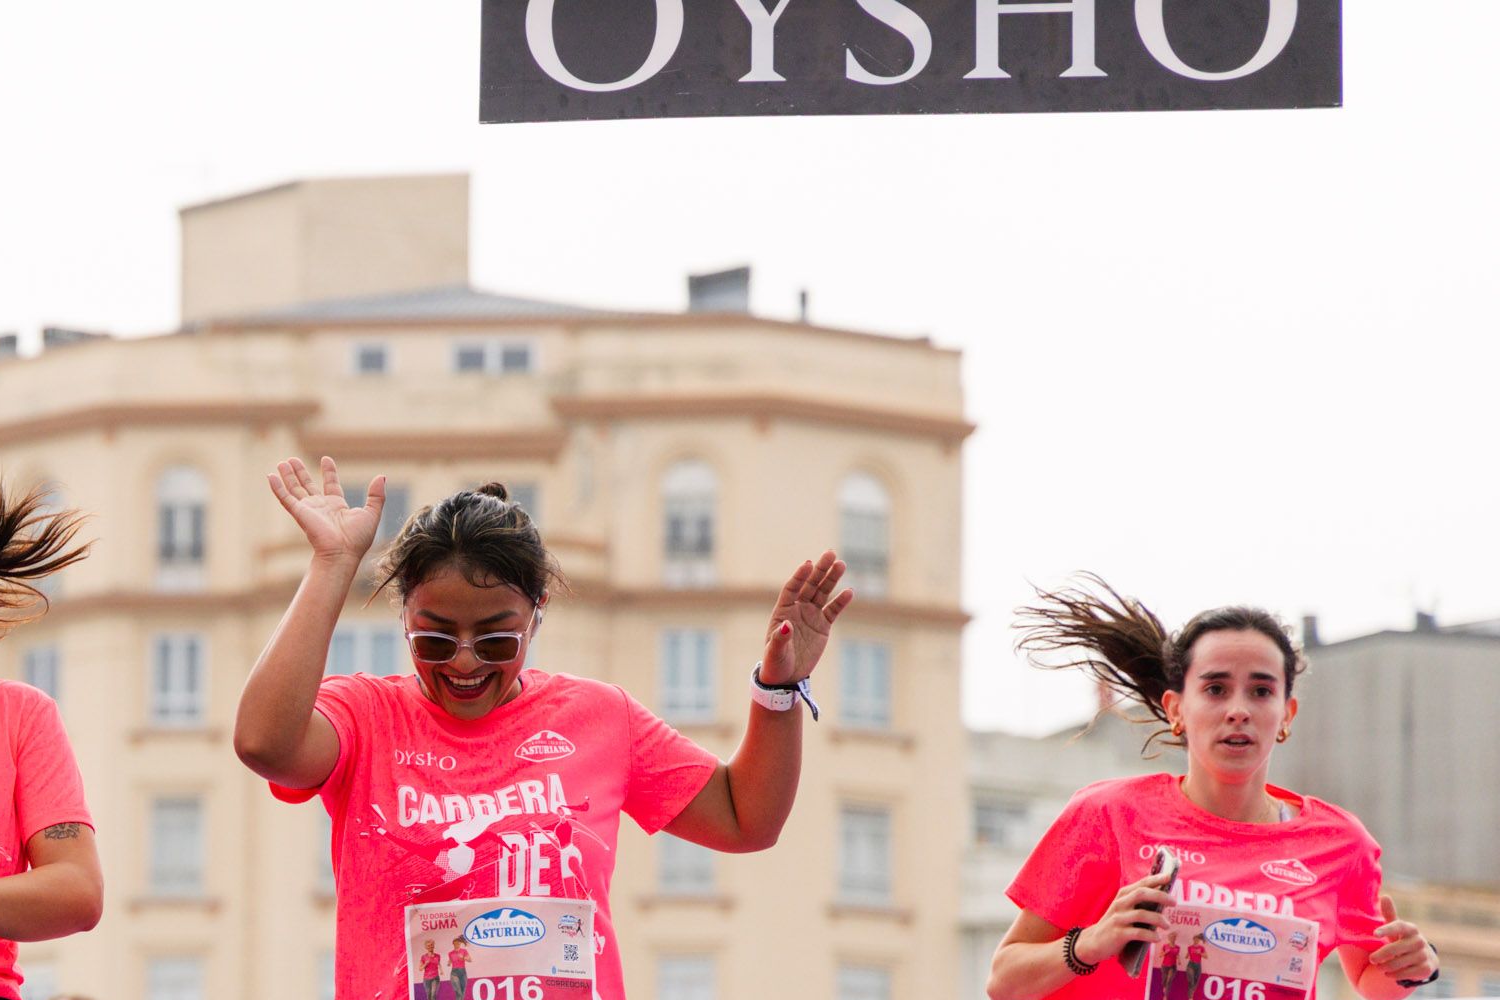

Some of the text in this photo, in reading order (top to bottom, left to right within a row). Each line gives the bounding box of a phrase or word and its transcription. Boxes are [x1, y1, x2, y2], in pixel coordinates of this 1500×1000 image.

[524, 0, 1299, 92] OYSHO
[521, 744, 571, 756] ASTURIANA
[397, 773, 572, 828] CARRERA
[497, 831, 556, 897] DE
[1169, 878, 1294, 917] ARRERA
[422, 918, 458, 932] SUMA
[430, 912, 457, 920] DORSAL
[471, 924, 541, 941] ASTURIANA
[1210, 927, 1271, 949] ASTURIANA
[546, 979, 590, 989] CORREDORA
